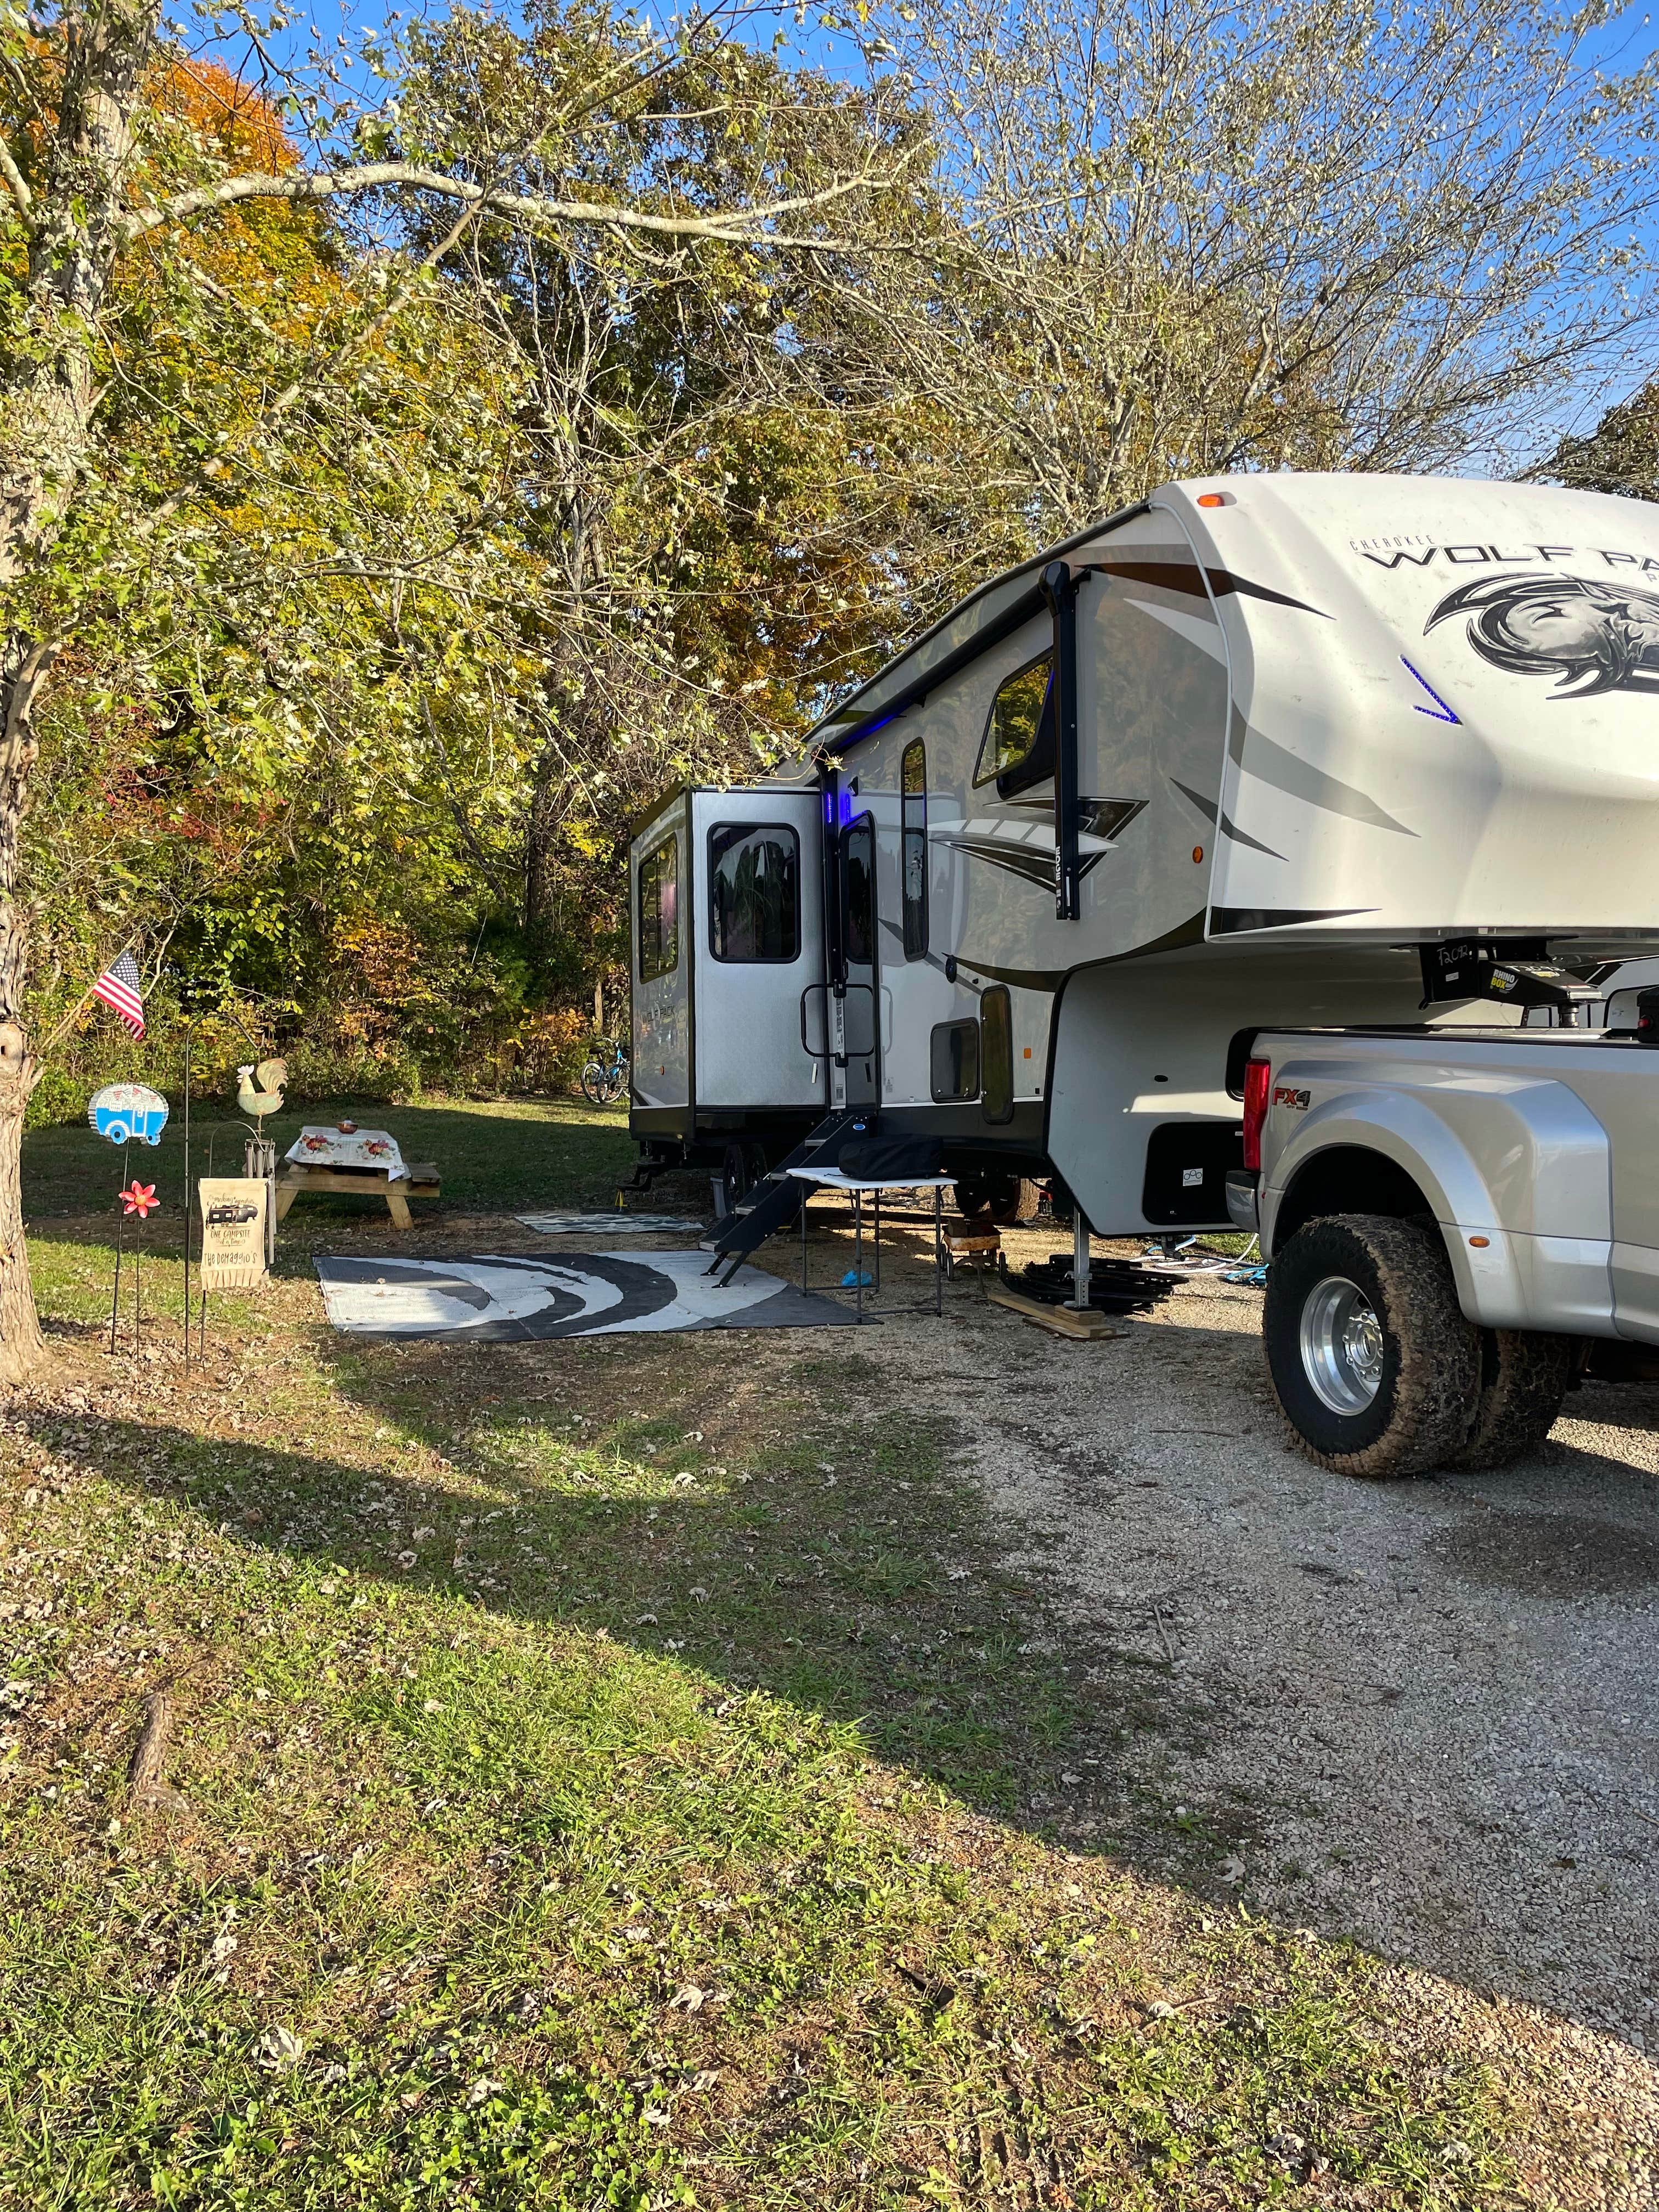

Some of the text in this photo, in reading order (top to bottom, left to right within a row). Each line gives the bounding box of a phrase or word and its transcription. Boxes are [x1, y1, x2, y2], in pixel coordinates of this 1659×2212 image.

[1350, 534, 1435, 551] CHEROKEE
[1355, 544, 1577, 571] WOLF
[1437, 944, 1468, 966] T2092
[1491, 977, 1506, 990] BOX
[1493, 969, 1515, 984] RHINO
[1272, 1087, 1311, 1107] FX4
[211, 1229, 251, 1239] ONE CAMPSITE
